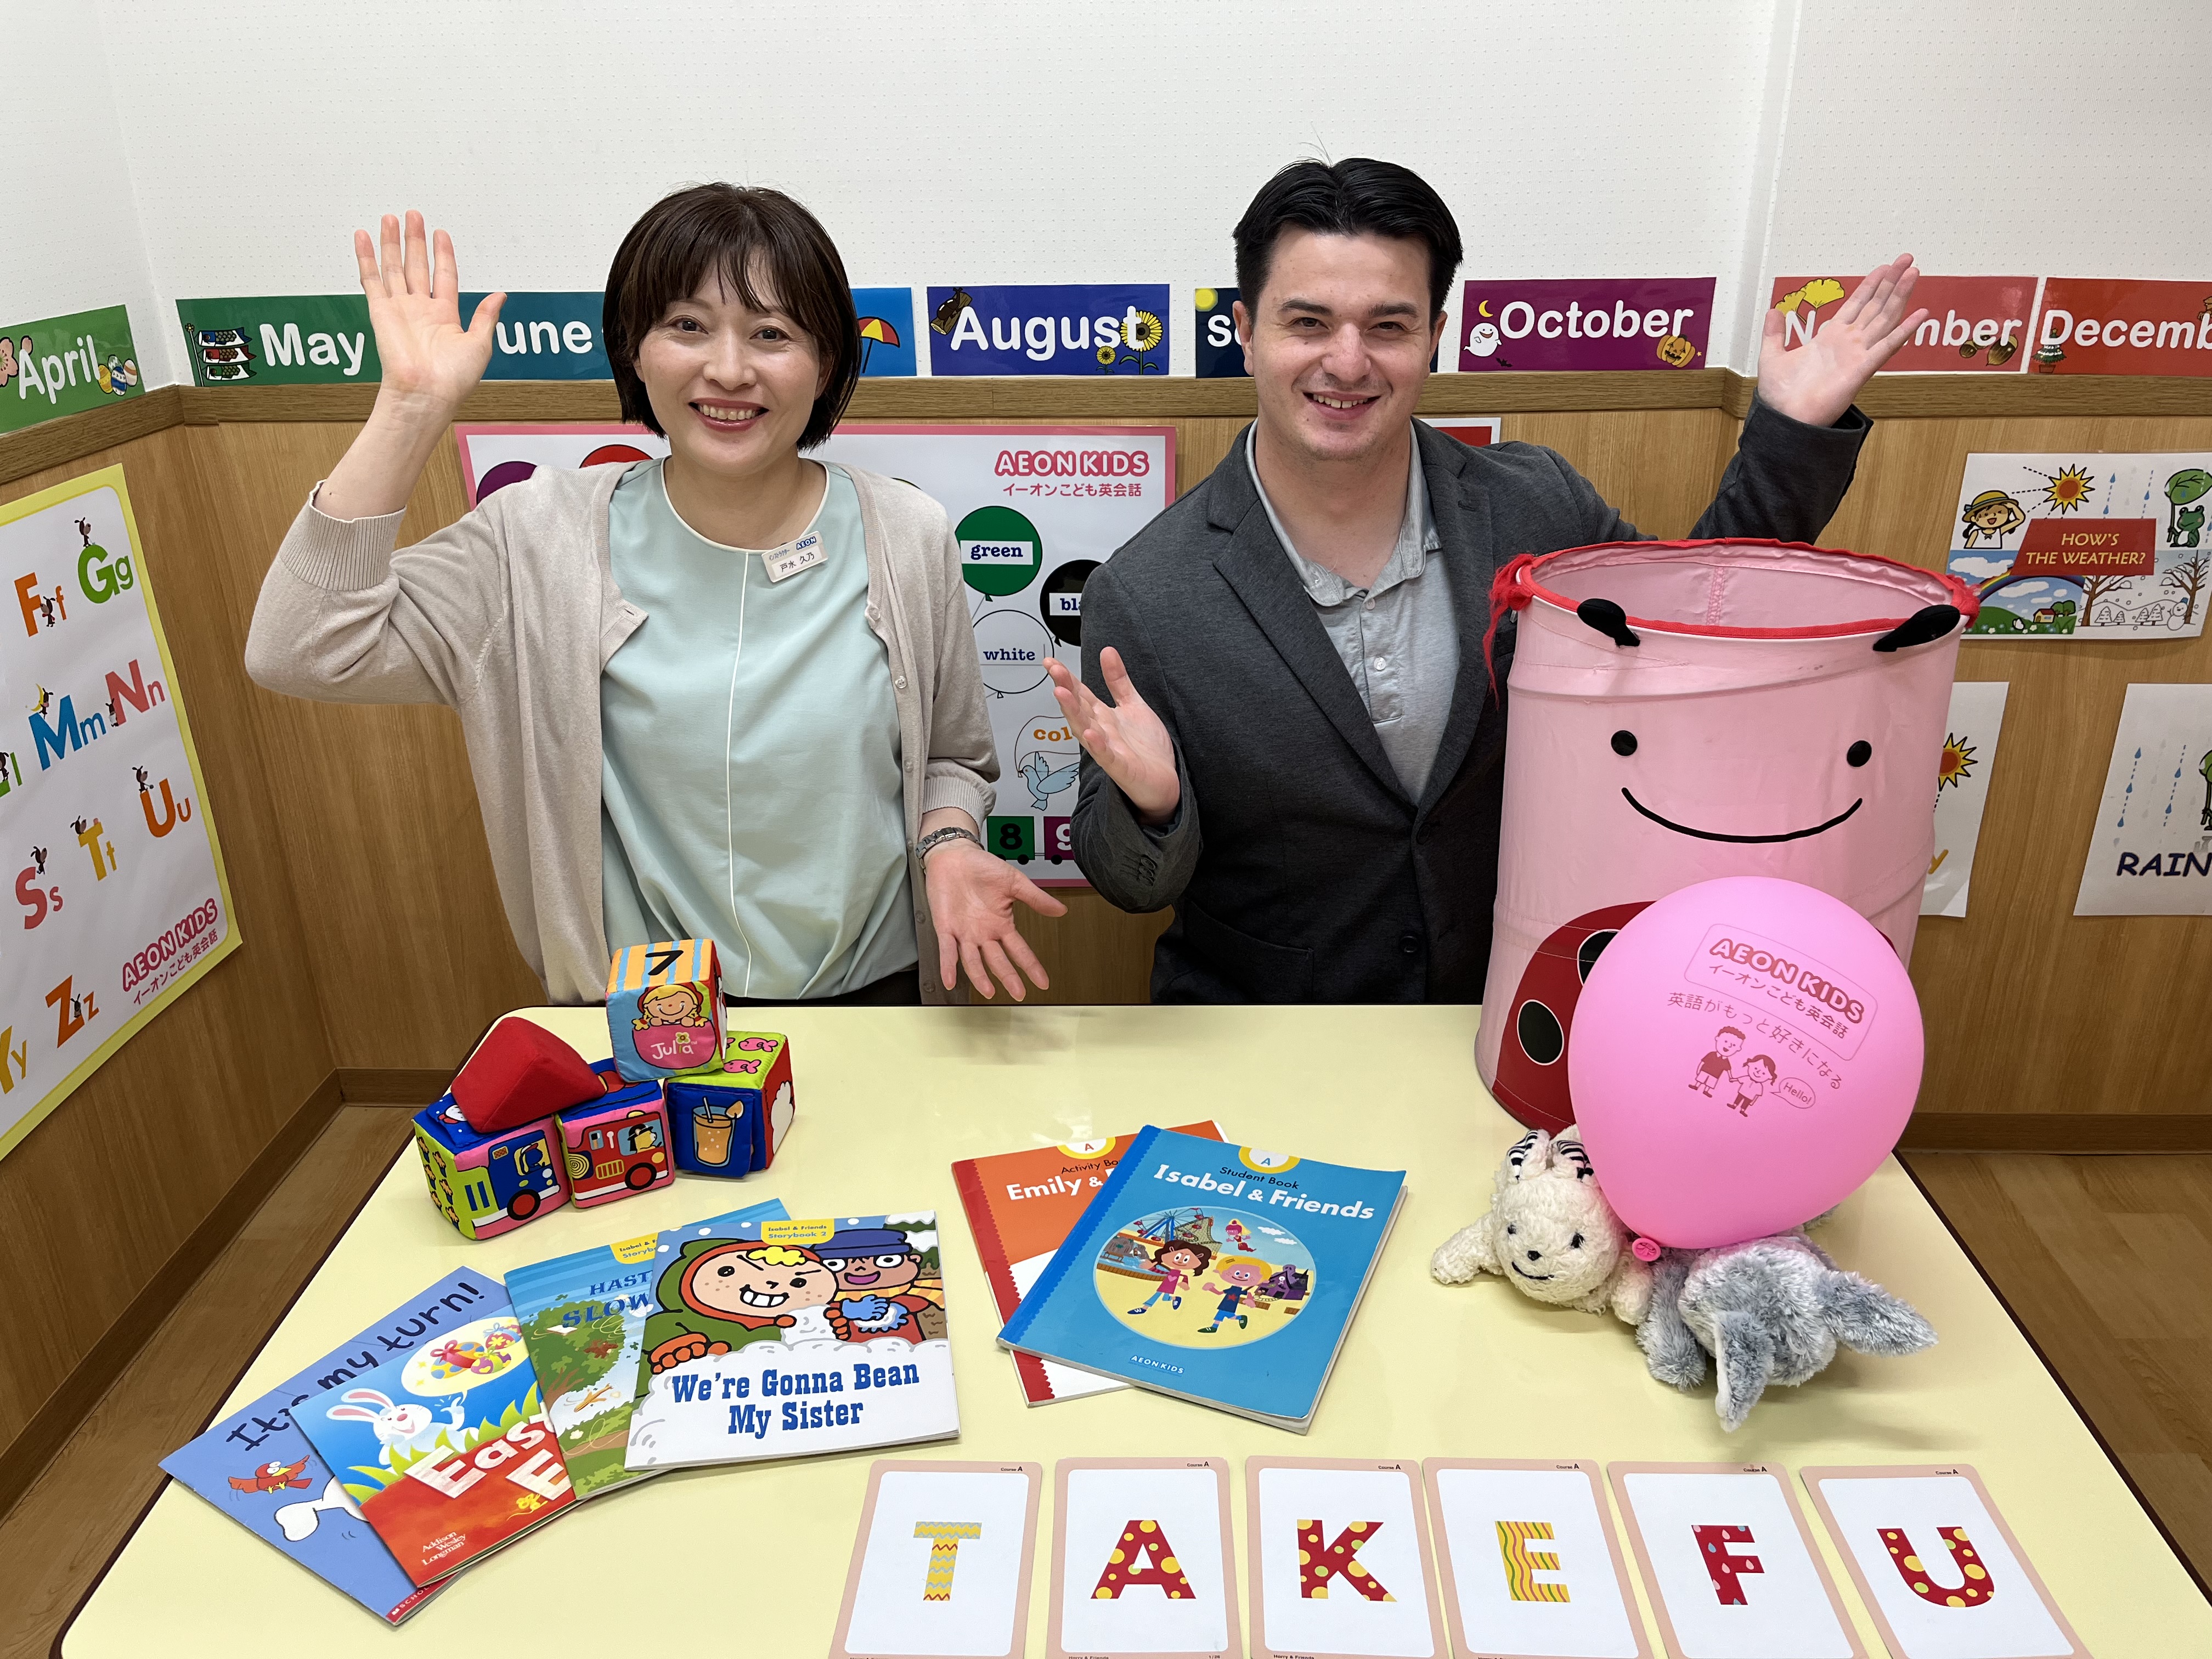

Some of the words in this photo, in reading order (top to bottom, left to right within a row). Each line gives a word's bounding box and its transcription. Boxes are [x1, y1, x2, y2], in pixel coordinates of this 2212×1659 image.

[950, 306, 1144, 361] August
[1500, 300, 1694, 338] October
[1784, 309, 2023, 346] Nmber
[259, 323, 365, 376] May
[496, 320, 592, 354] une
[19, 334, 100, 404] April
[994, 450, 1077, 476] AEON
[1079, 450, 1150, 476] KIDS
[1003, 482, 1142, 497] イーオンこども英会話
[796, 536, 817, 550] AEON
[970, 544, 1023, 560] green
[2061, 533, 2119, 546] HOW'S
[2026, 552, 2057, 565] THE
[2062, 552, 2146, 565] WEATHER?
[983, 648, 1035, 661] white
[999, 823, 1023, 850] 8
[2117, 851, 2212, 877] RAIN
[122, 930, 177, 992] AEON
[174, 898, 218, 948] KIDS
[134, 928, 218, 1005] イーオンこども英会話
[645, 950, 684, 975] 7
[1709, 938, 1798, 984] AEON
[1797, 971, 1865, 1024] KIDS
[1709, 963, 1849, 1040] イーオンこども英会話
[651, 1039, 694, 1059] Julia
[1667, 991, 1842, 1090] 英語がもっと好きになる
[1783, 1082, 1812, 1104] Hello!
[1061, 1163, 1101, 1175] Activity
[1260, 1158, 1271, 1166] A
[1006, 1175, 1082, 1200] Emily
[1153, 1164, 1246, 1197] Isabel
[1247, 1189, 1263, 1203] &
[1268, 1189, 1375, 1219] Friends
[1219, 1166, 1265, 1183] Student
[1268, 1177, 1300, 1190] Book
[619, 1243, 642, 1252] Isabel
[377, 1282, 485, 1351] turn!
[1130, 1355, 1159, 1368] AEON
[1159, 1362, 1184, 1374] KIDS
[672, 1372, 750, 1403] We're
[762, 1368, 844, 1398] Gonna
[853, 1363, 919, 1393] Bean
[728, 1404, 771, 1440] My
[781, 1400, 864, 1432] Sister
[421, 1541, 465, 1566] Longman
[422, 1532, 457, 1553] Addison
[435, 1533, 466, 1551] Wesley
[913, 1521, 982, 1601] T
[1090, 1520, 1197, 1599] A
[1296, 1519, 1398, 1602] K
[1494, 1520, 1571, 1603] E
[1691, 1525, 1765, 1605] F
[1876, 1526, 1995, 1608] U
